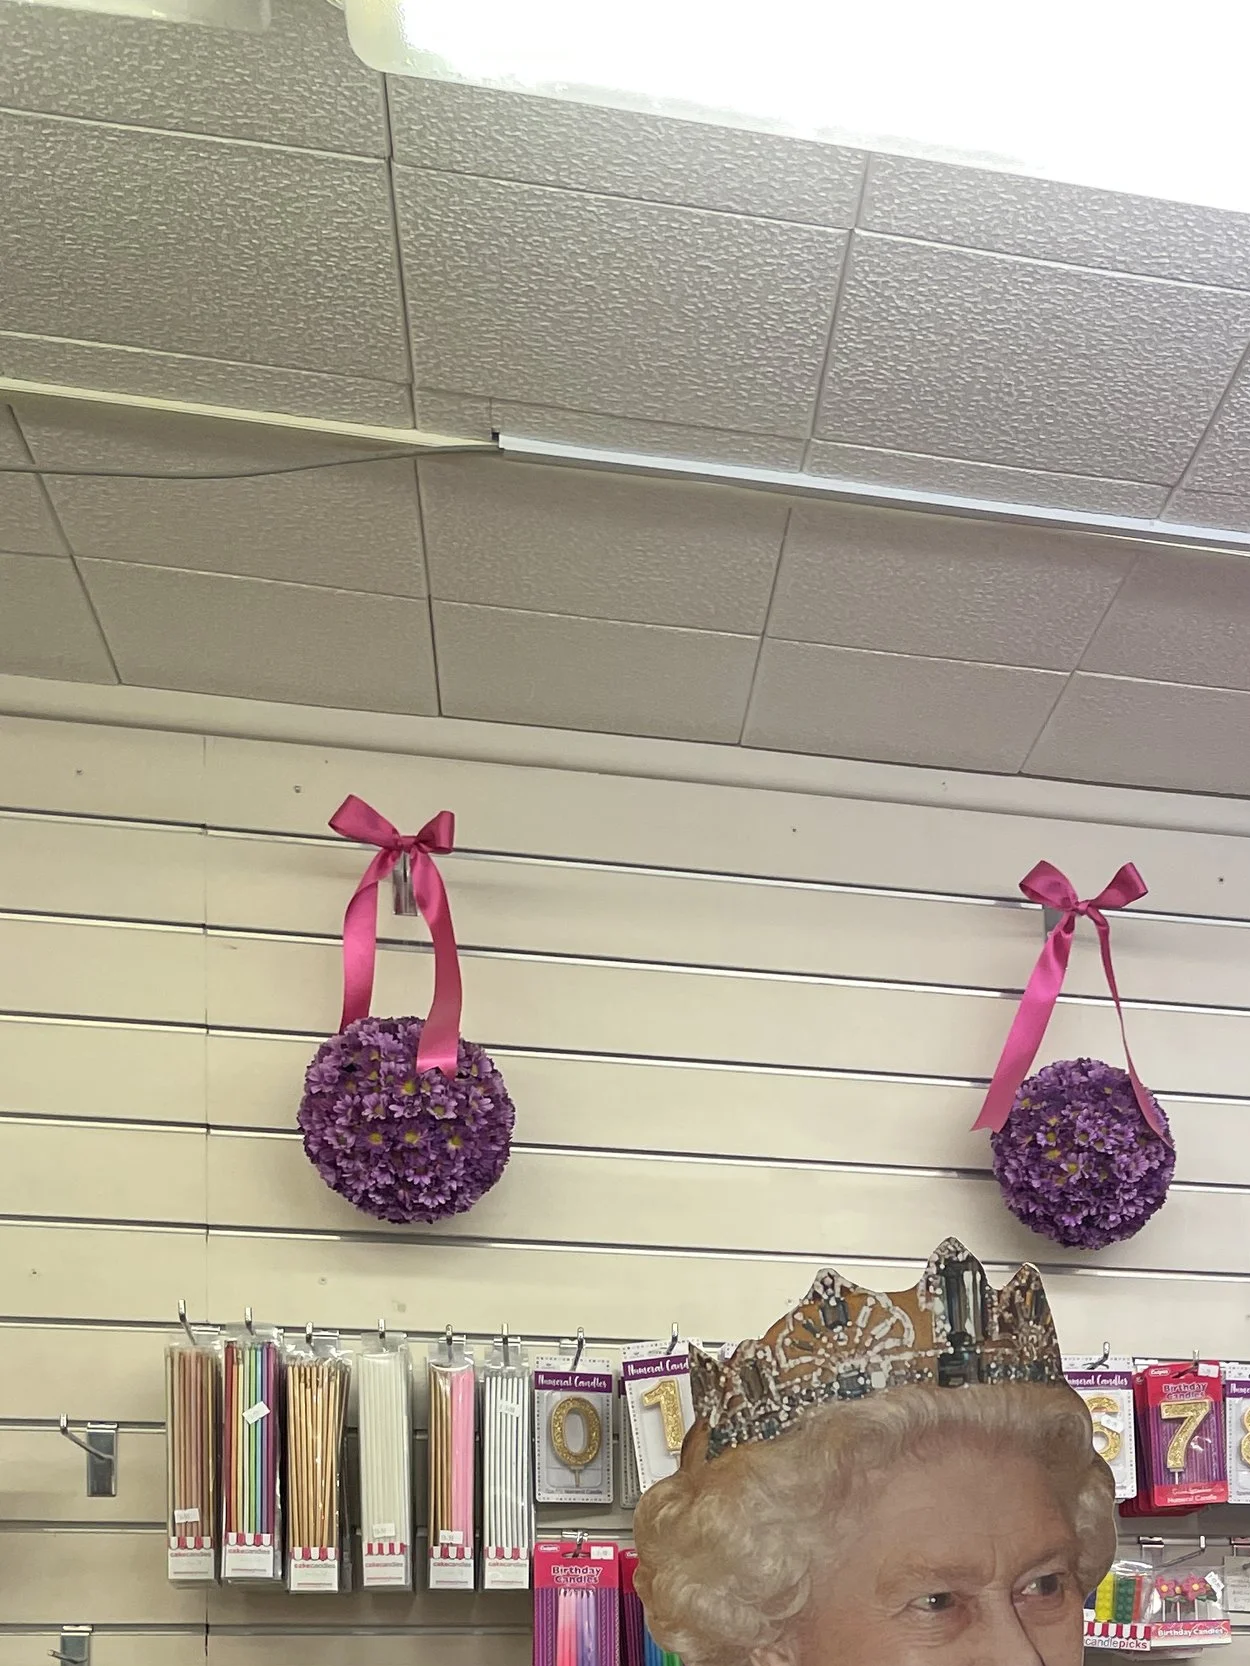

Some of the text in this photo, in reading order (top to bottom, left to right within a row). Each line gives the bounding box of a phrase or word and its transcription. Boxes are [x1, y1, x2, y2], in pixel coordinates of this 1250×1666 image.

[552, 1565, 602, 1577] Birthday
[554, 1575, 599, 1584] Candles
[1157, 1627, 1223, 1638] Birthday Candles
